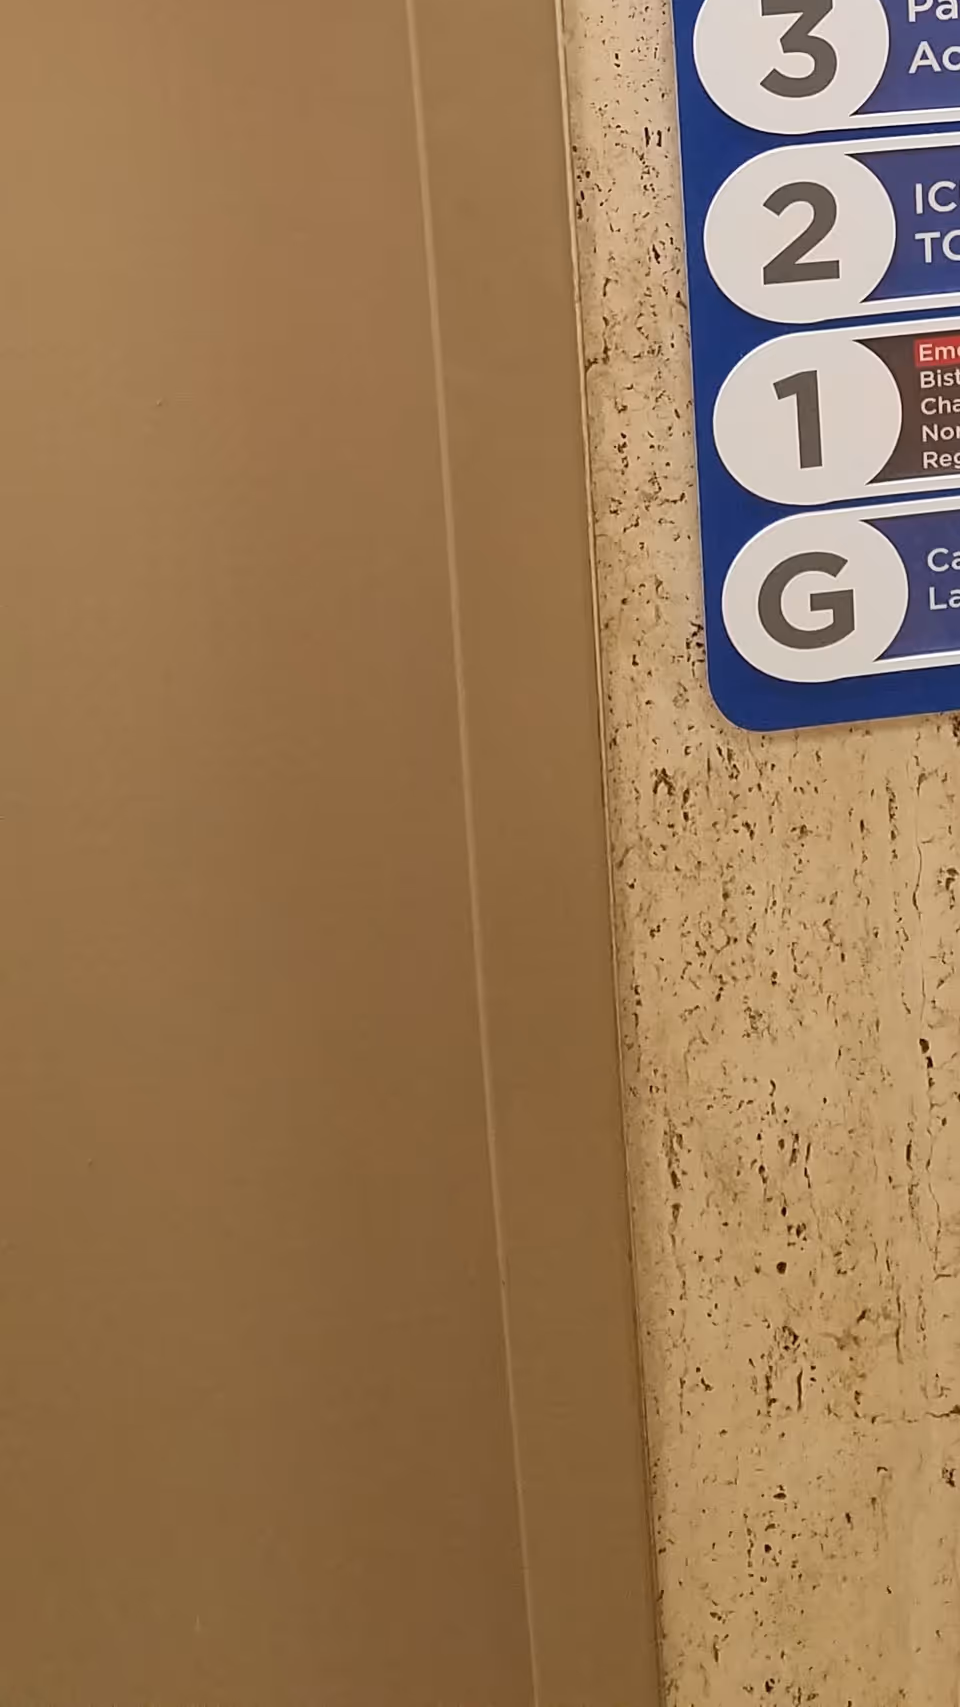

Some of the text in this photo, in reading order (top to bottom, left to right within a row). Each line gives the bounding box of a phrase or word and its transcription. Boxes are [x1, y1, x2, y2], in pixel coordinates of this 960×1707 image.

[763, 182, 840, 285] 2
[773, 370, 822, 469] 1
[758, 552, 854, 649] G
